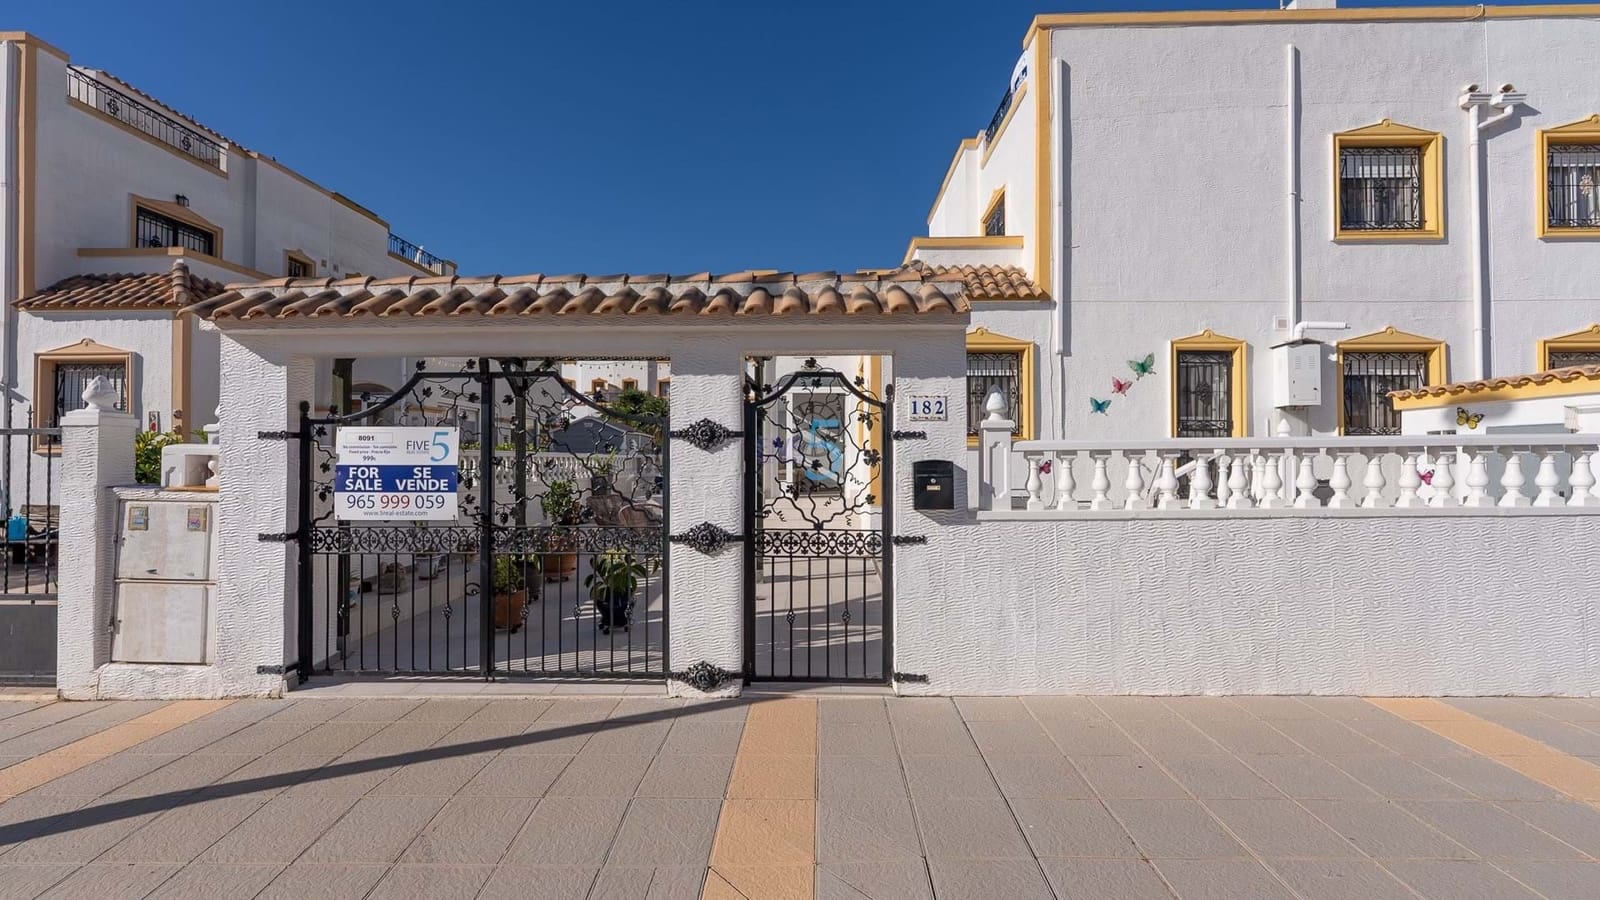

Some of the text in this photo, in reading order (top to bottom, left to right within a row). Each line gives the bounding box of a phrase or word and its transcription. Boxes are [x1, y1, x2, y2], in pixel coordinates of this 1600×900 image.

[911, 400, 944, 415] 182
[406, 440, 430, 451] FIVE
[430, 431, 450, 462] 5
[349, 466, 380, 479] FOR
[412, 466, 432, 479] SE
[344, 479, 383, 491] SALE
[395, 479, 449, 491] VENDE
[346, 494, 446, 509] 965 999 059
